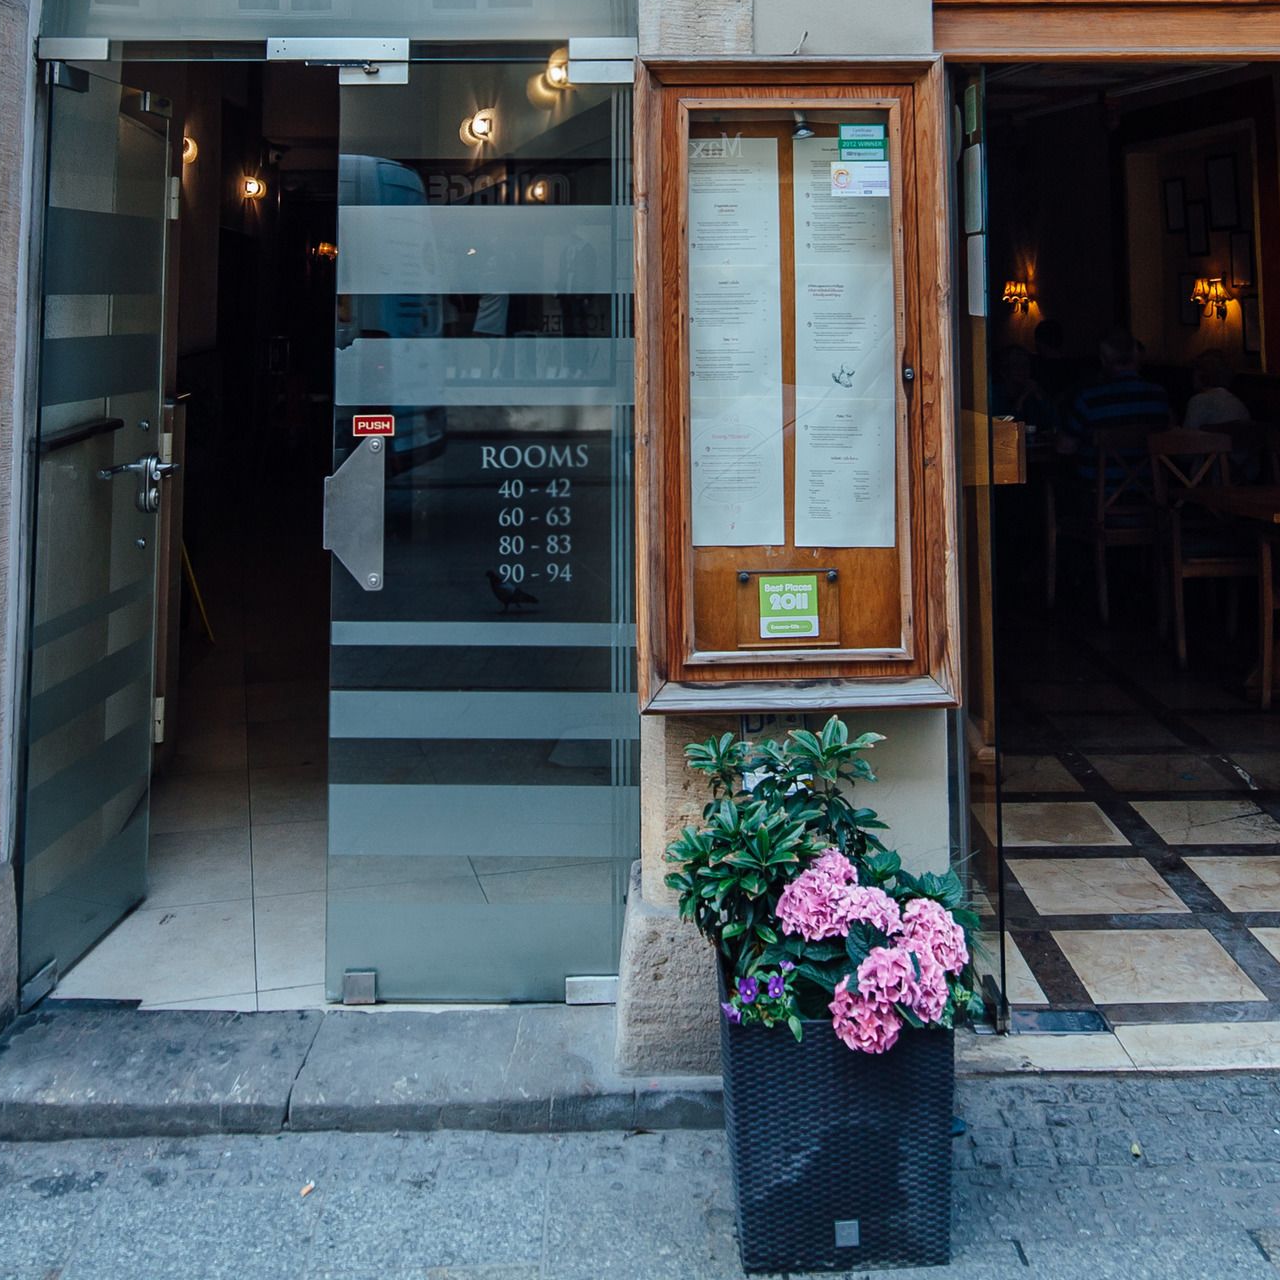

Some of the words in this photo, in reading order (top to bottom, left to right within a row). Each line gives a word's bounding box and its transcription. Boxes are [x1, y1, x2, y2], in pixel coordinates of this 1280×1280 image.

[357, 419, 390, 431] PUSH
[480, 444, 589, 470] ROOMS
[498, 479, 524, 499] 40
[546, 479, 572, 497] 42
[498, 507, 524, 527] 60
[546, 507, 572, 526] 63
[498, 535, 524, 556] 80
[546, 535, 572, 555] 83
[498, 563, 524, 584] 90
[546, 563, 572, 582] 94
[764, 584, 784, 592] Best
[785, 583, 812, 591] Places
[769, 592, 808, 610] 2011
